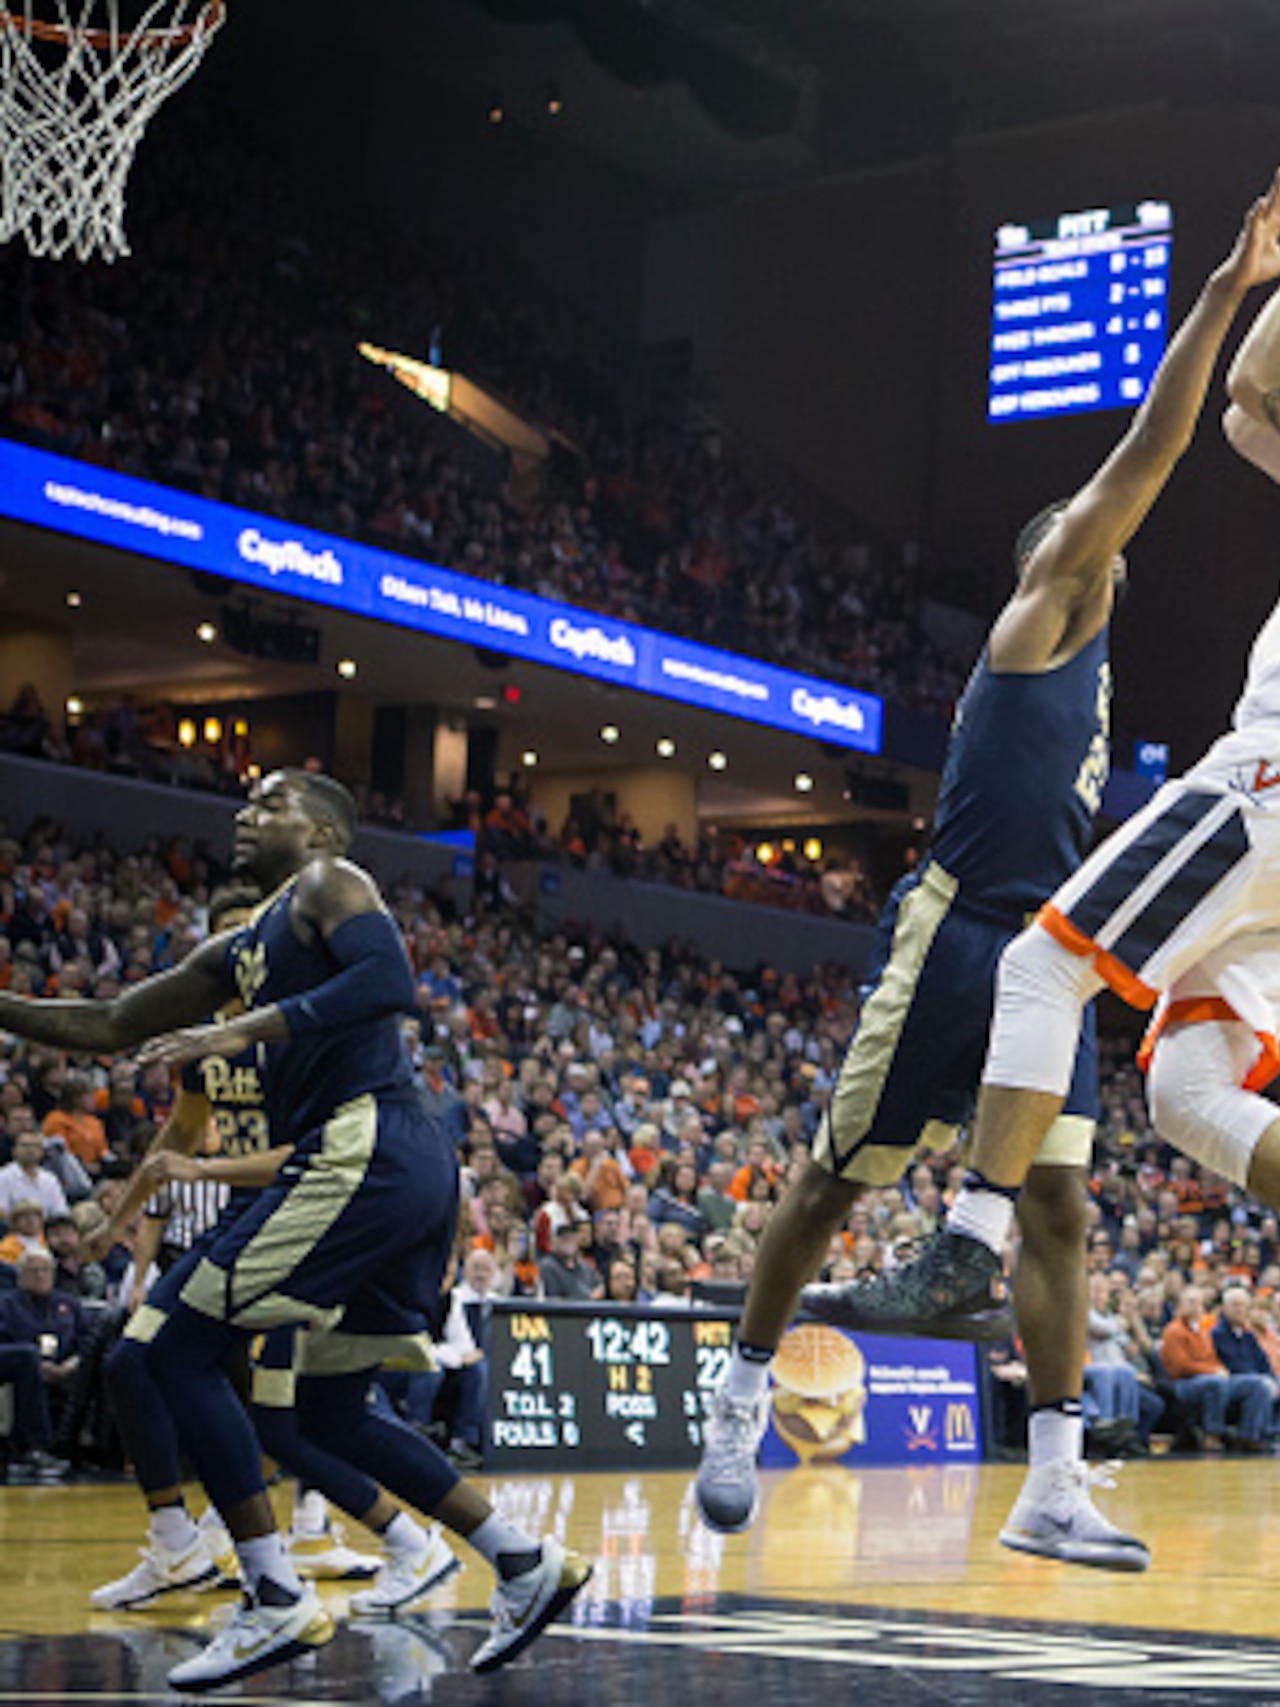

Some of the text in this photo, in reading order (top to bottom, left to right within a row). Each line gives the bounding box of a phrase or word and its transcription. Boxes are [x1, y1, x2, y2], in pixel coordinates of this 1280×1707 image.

[239, 529, 342, 584] CapTech
[550, 618, 635, 665] CapTech
[791, 688, 864, 731] CapTech
[199, 1053, 266, 1104] Pitt
[586, 1318, 670, 1364] 12:42
[511, 1343, 553, 1386] 41
[695, 1348, 731, 1387] 22
[494, 1420, 558, 1446] FOULS
